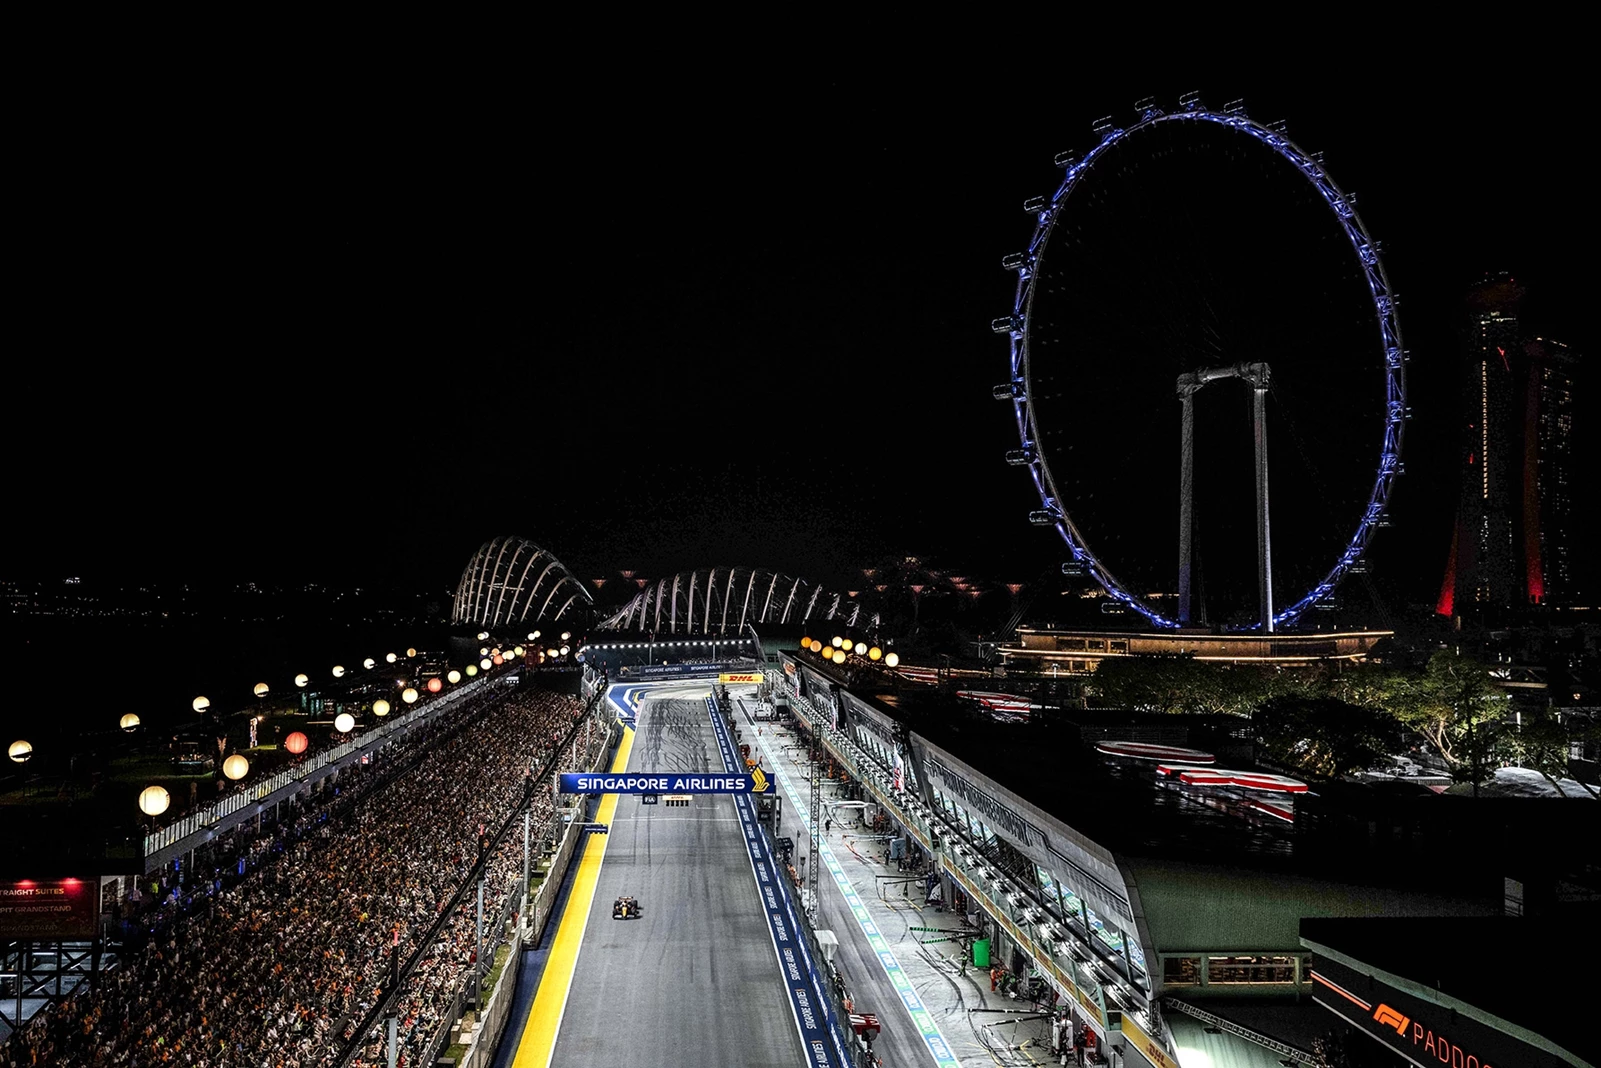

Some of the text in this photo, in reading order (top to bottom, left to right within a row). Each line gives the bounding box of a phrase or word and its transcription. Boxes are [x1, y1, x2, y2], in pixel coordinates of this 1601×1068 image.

[577, 778, 745, 790] SINGAPORE AIRLINES
[801, 1007, 817, 1030] SINGAPORE
[1413, 1022, 1493, 1068] PADDO
